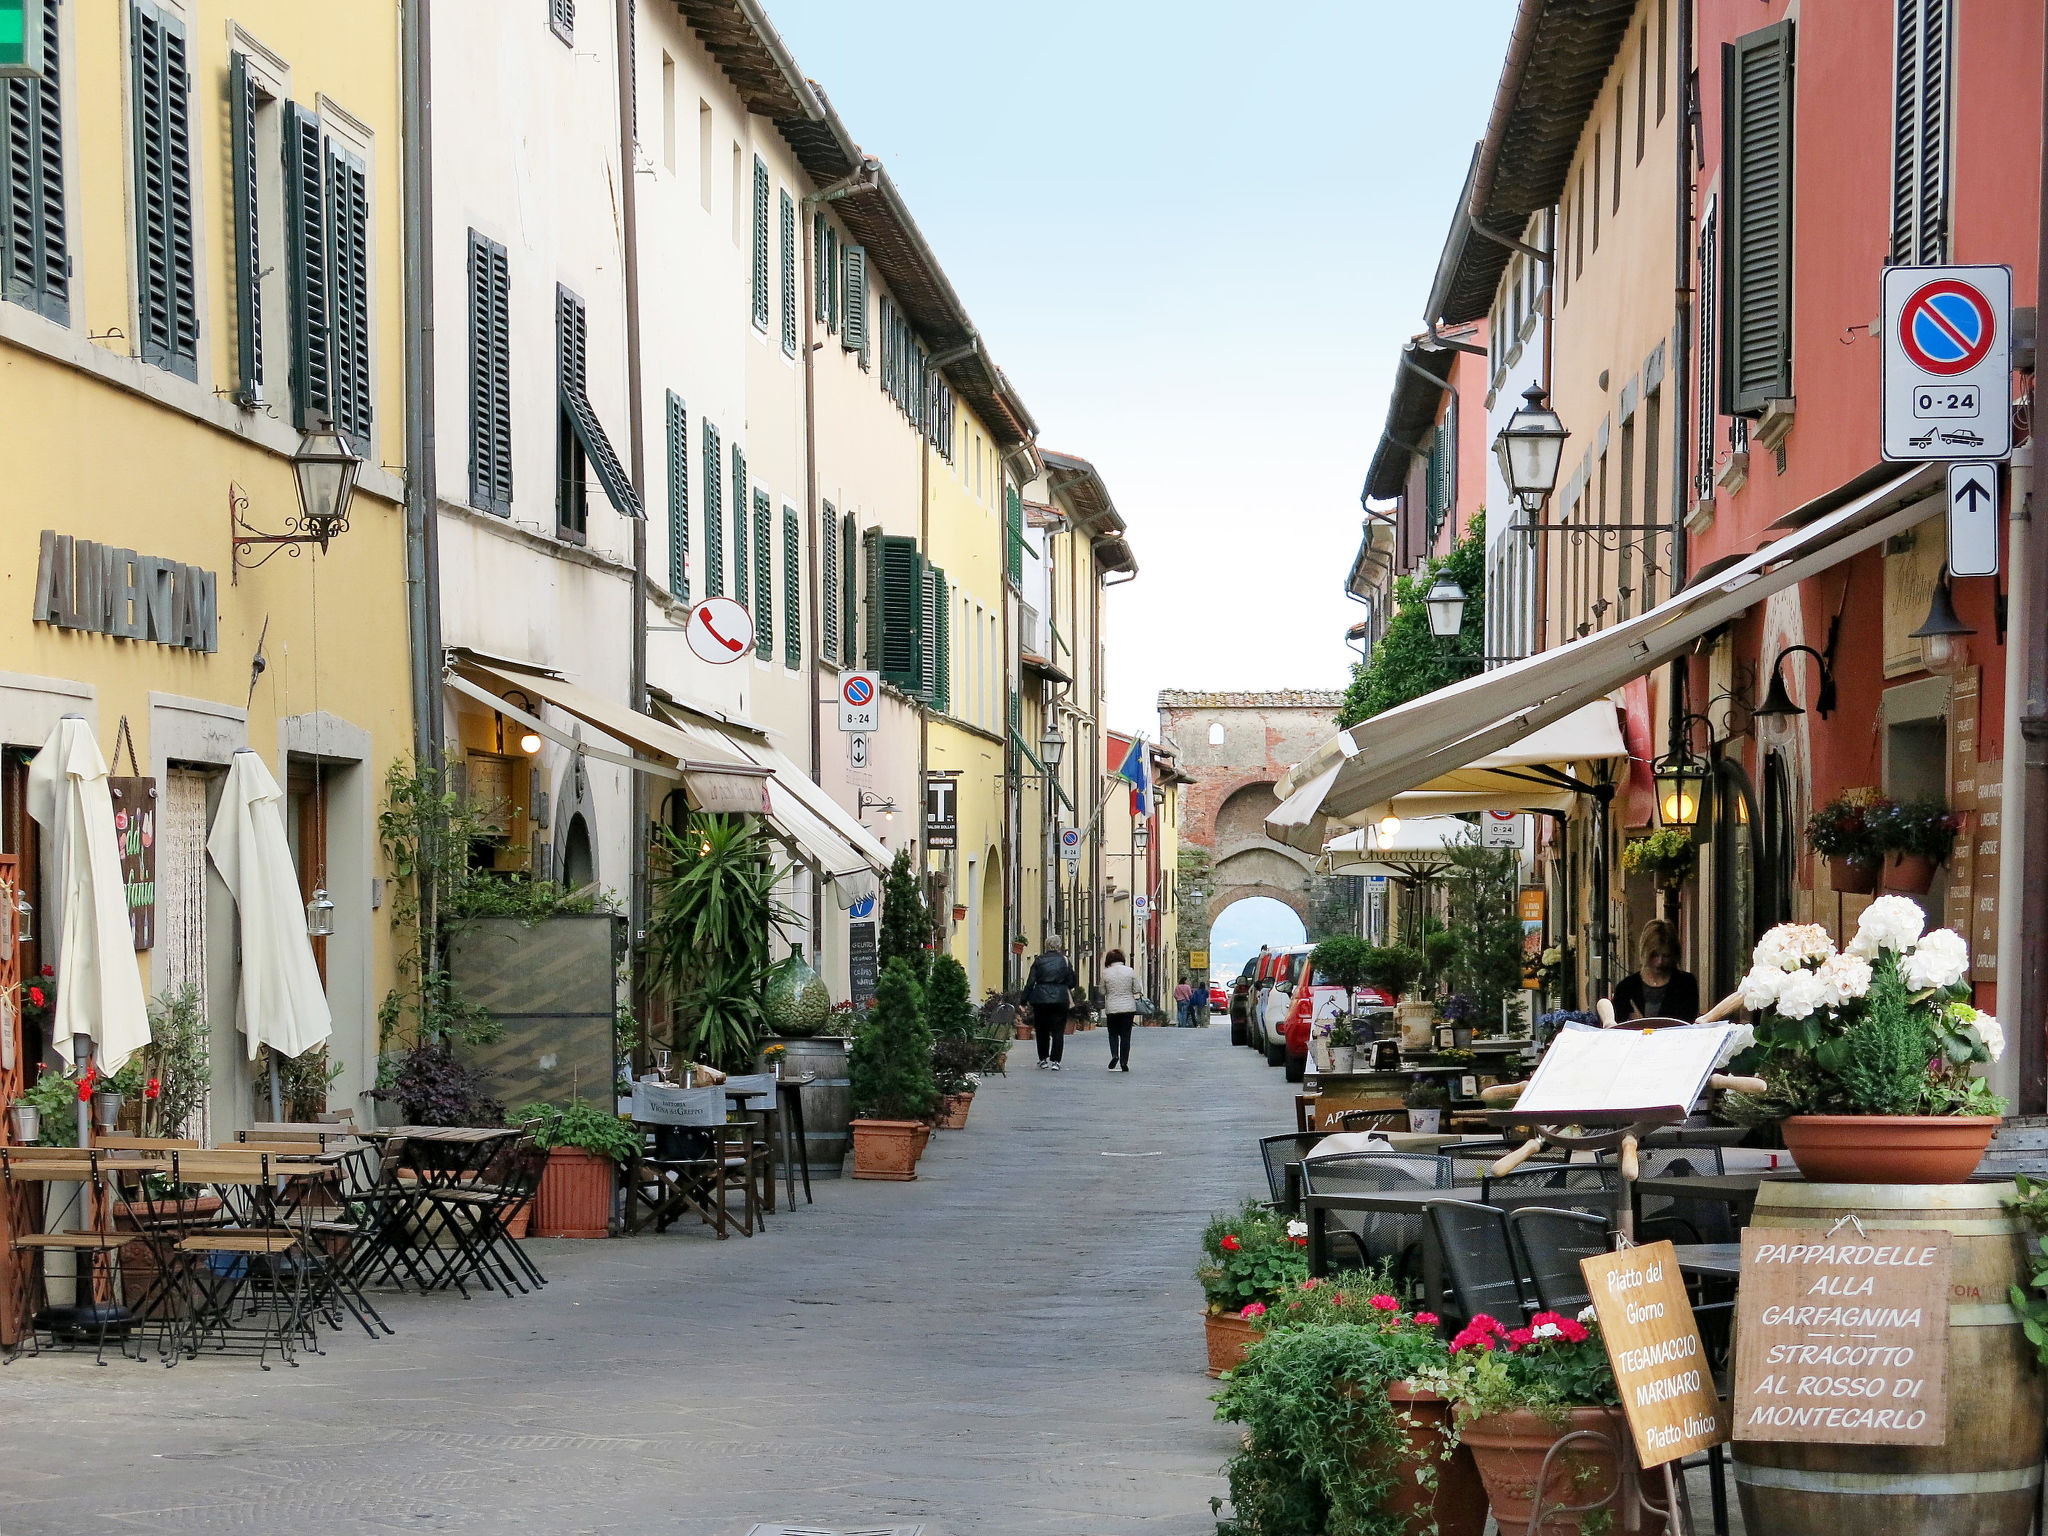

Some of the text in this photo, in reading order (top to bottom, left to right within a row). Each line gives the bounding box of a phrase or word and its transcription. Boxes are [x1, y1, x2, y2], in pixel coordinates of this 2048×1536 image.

[1755, 1243, 1937, 1266] PAPPARDELLE
[1607, 1260, 1663, 1293] Piatto del
[1807, 1275, 1875, 1296] ALLA
[1626, 1301, 1664, 1325] Giorno
[1761, 1305, 1922, 1328] GARFAGNINA
[1618, 1333, 1697, 1375] TEGAMACCIO
[1766, 1344, 1914, 1367] STRACOTTO
[1636, 1369, 1701, 1408] MARINARO
[1754, 1375, 1924, 1399] AL ROSSO DI
[1747, 1406, 1927, 1430] MONTECARLO
[1646, 1412, 1716, 1451] Piatto Unico
